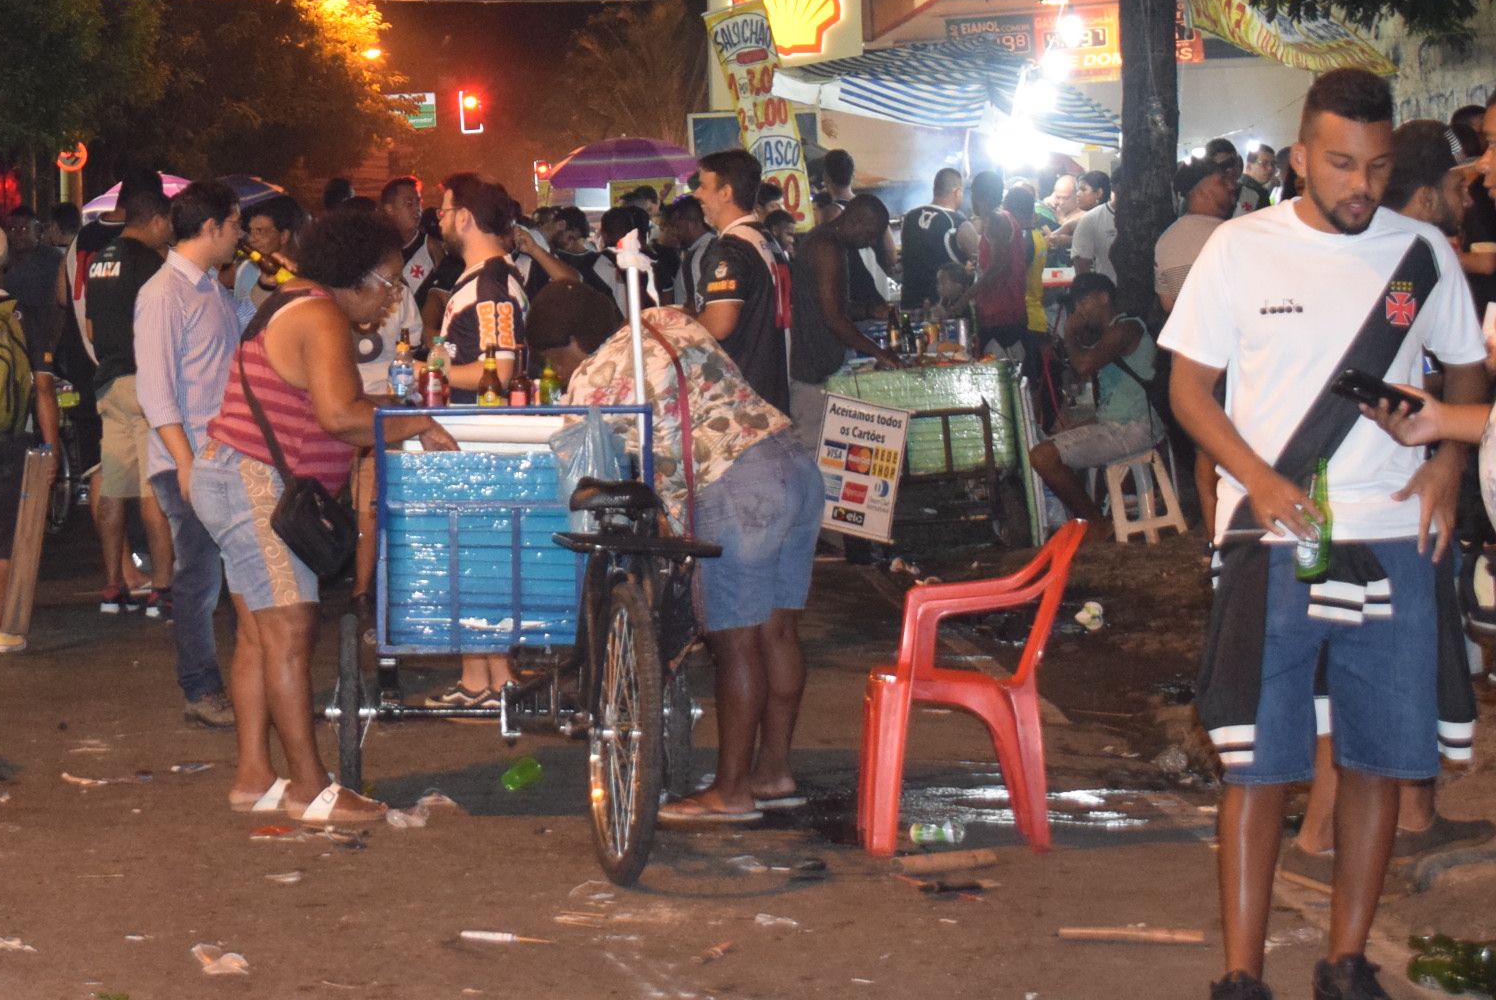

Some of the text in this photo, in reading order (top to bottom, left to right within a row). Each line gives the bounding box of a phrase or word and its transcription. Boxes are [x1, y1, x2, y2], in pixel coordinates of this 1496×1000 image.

[88, 261, 121, 279] CAIXA
[829, 403, 903, 429] Aceitamos todos
[840, 426, 849, 436] os
[826, 447, 843, 460] VISA
